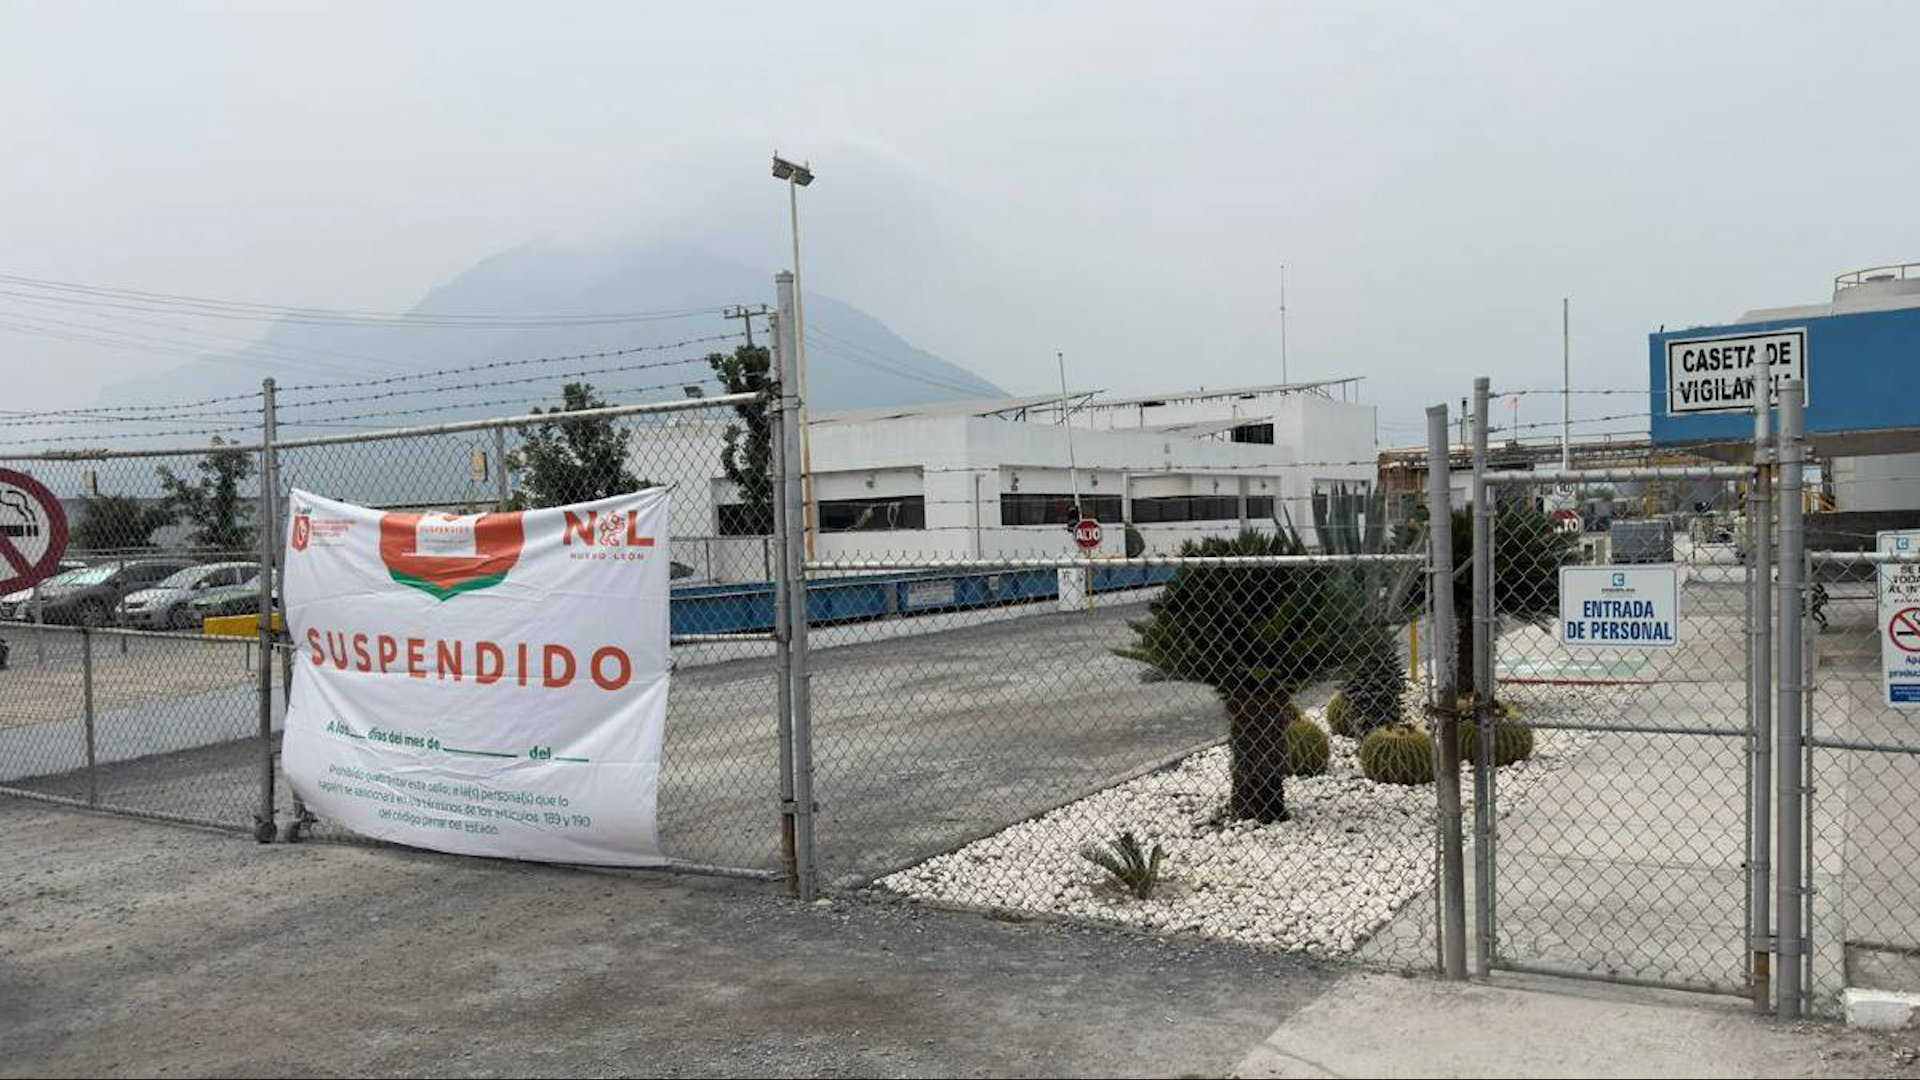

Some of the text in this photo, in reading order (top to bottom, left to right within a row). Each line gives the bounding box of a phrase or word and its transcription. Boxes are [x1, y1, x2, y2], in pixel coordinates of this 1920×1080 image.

[1683, 342, 1791, 372] CASETA DE
[1076, 528, 1101, 541] ALTO
[1583, 600, 1654, 618] ENTRADA
[1567, 621, 1673, 640] DE PERSONAL
[307, 627, 632, 690] SUSPENDIDO
[404, 735, 425, 748] mes
[427, 738, 440, 751] de
[529, 746, 551, 760] del
[535, 795, 556, 807] que
